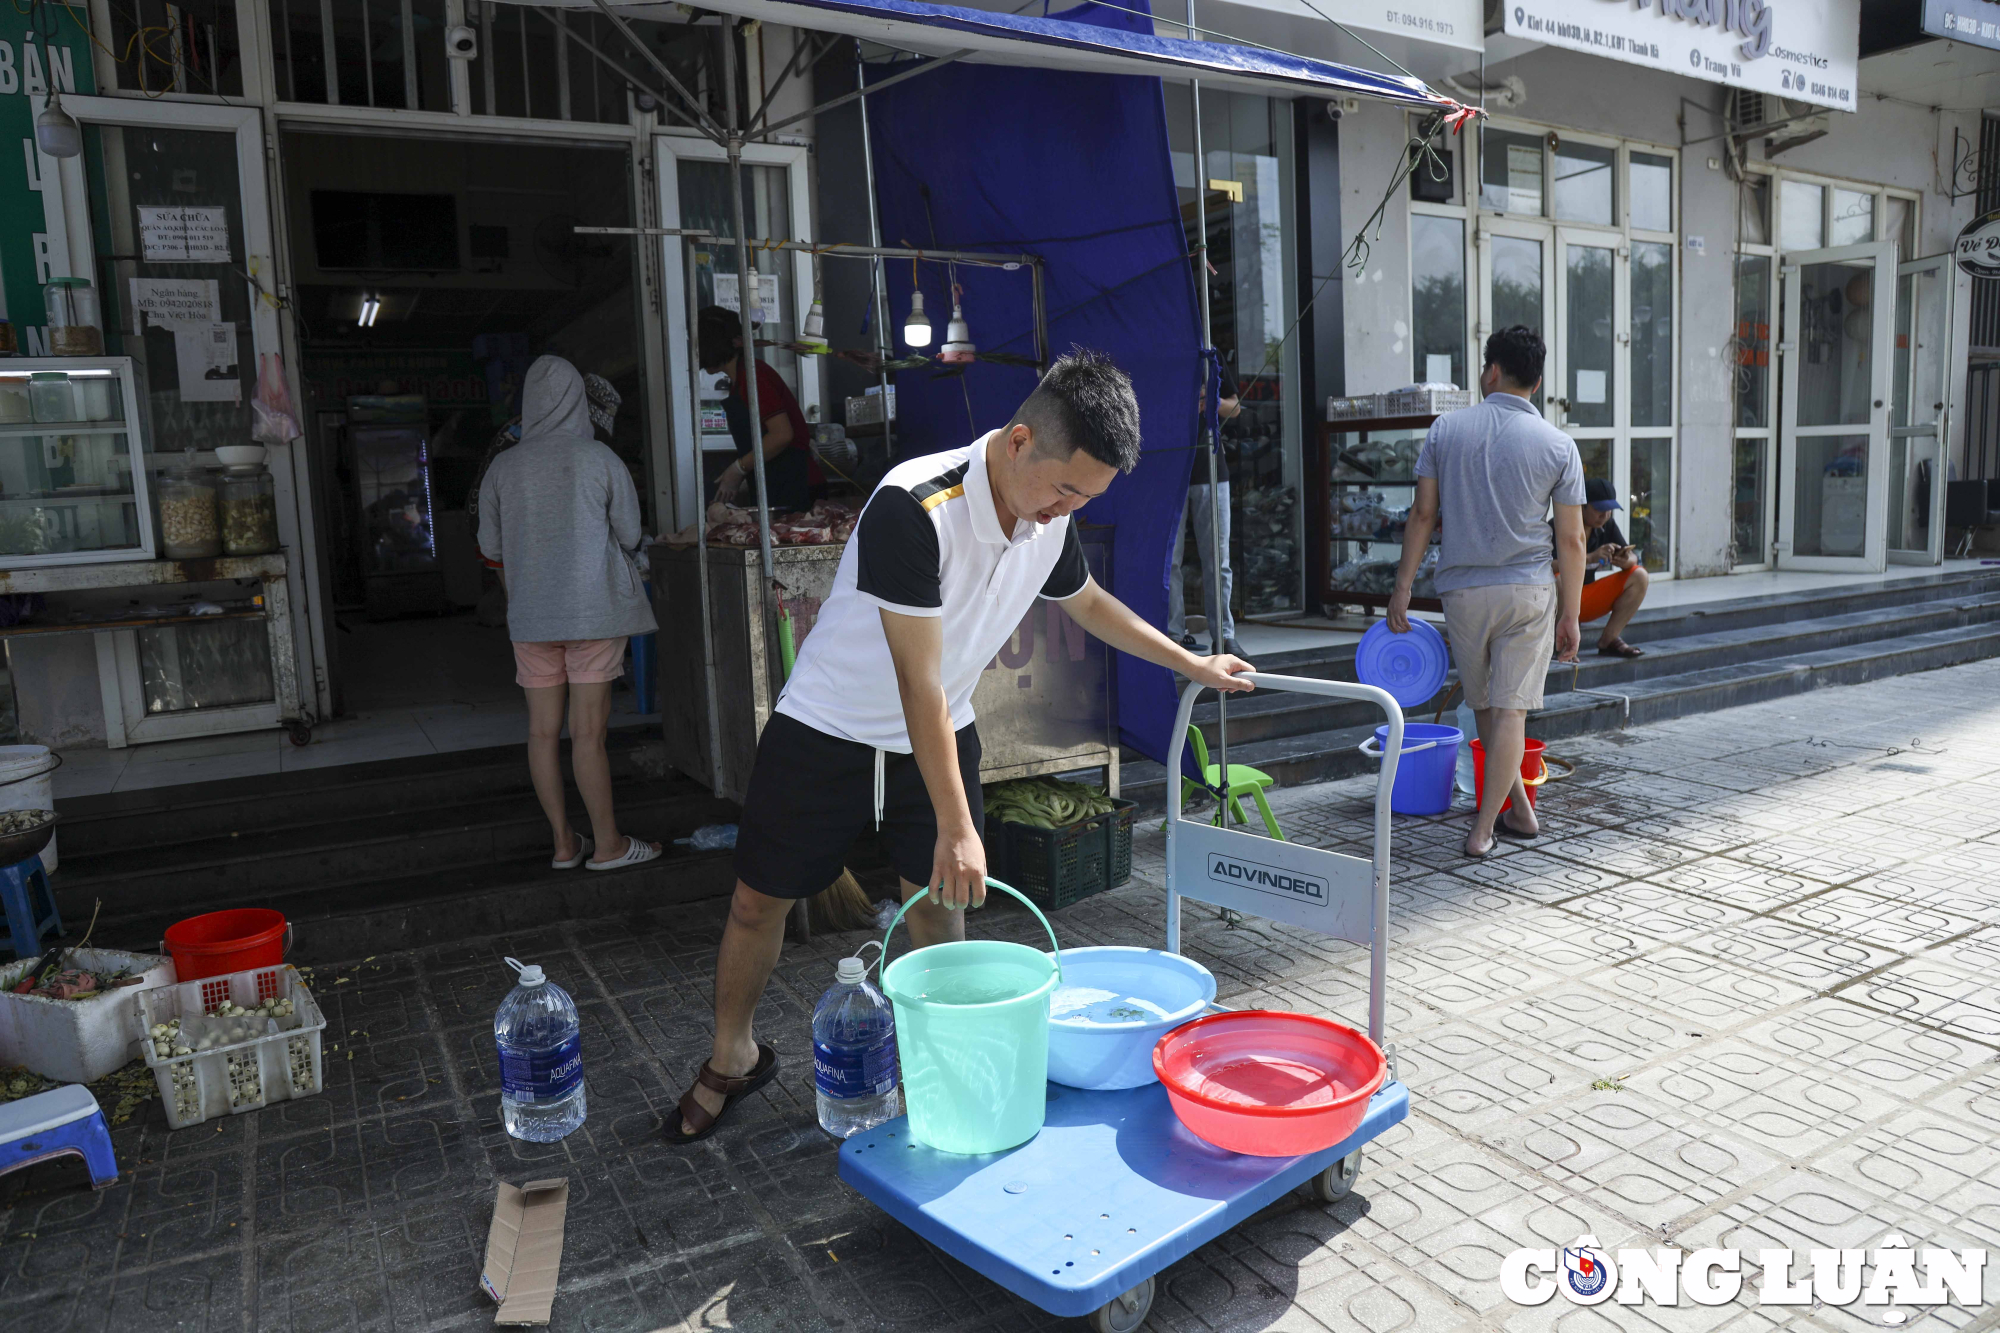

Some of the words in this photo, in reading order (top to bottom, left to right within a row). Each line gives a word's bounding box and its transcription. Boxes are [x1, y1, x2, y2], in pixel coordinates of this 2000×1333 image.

[1402, 13, 1454, 36] 094.916.1973
[1527, 14, 1543, 33] Kiot
[1545, 20, 1556, 36] 44
[1628, 38, 1649, 57] Thanh
[1650, 44, 1660, 59] Hà
[1704, 56, 1728, 78] Trang
[1811, 81, 1826, 98] 0346
[1213, 860, 1323, 899] ADVINDEQ
